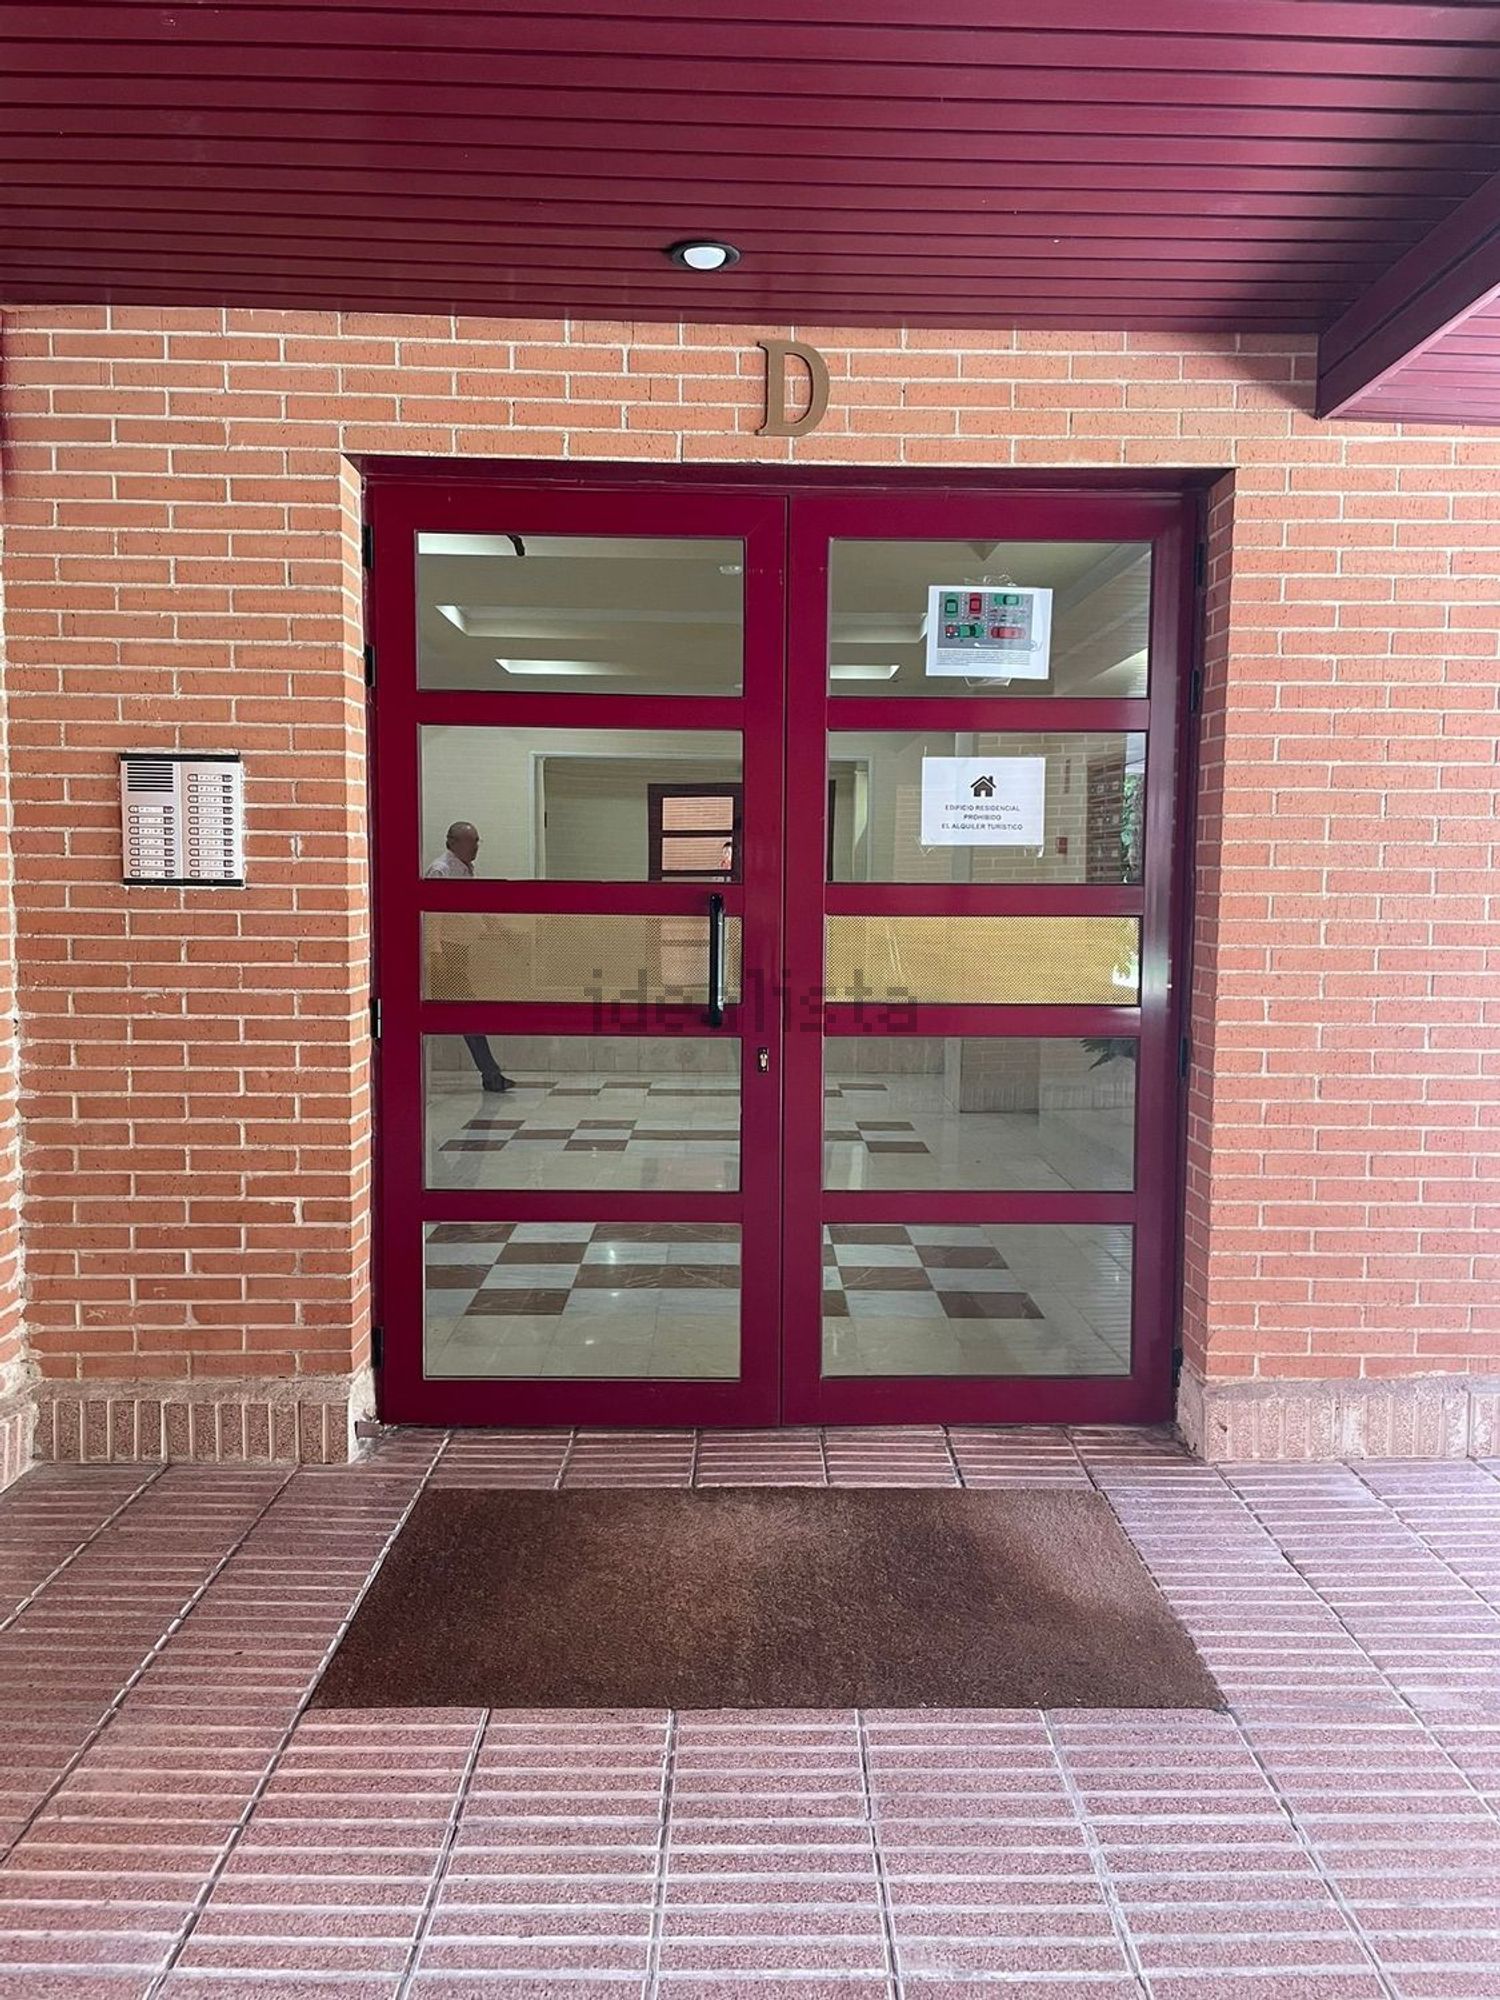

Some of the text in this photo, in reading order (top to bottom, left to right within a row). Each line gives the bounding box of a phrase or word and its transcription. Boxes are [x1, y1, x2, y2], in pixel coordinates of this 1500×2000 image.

[755, 340, 830, 437] D
[975, 804, 1020, 812] RESIDENCIAL
[963, 813, 1002, 821] PROHIBIDO
